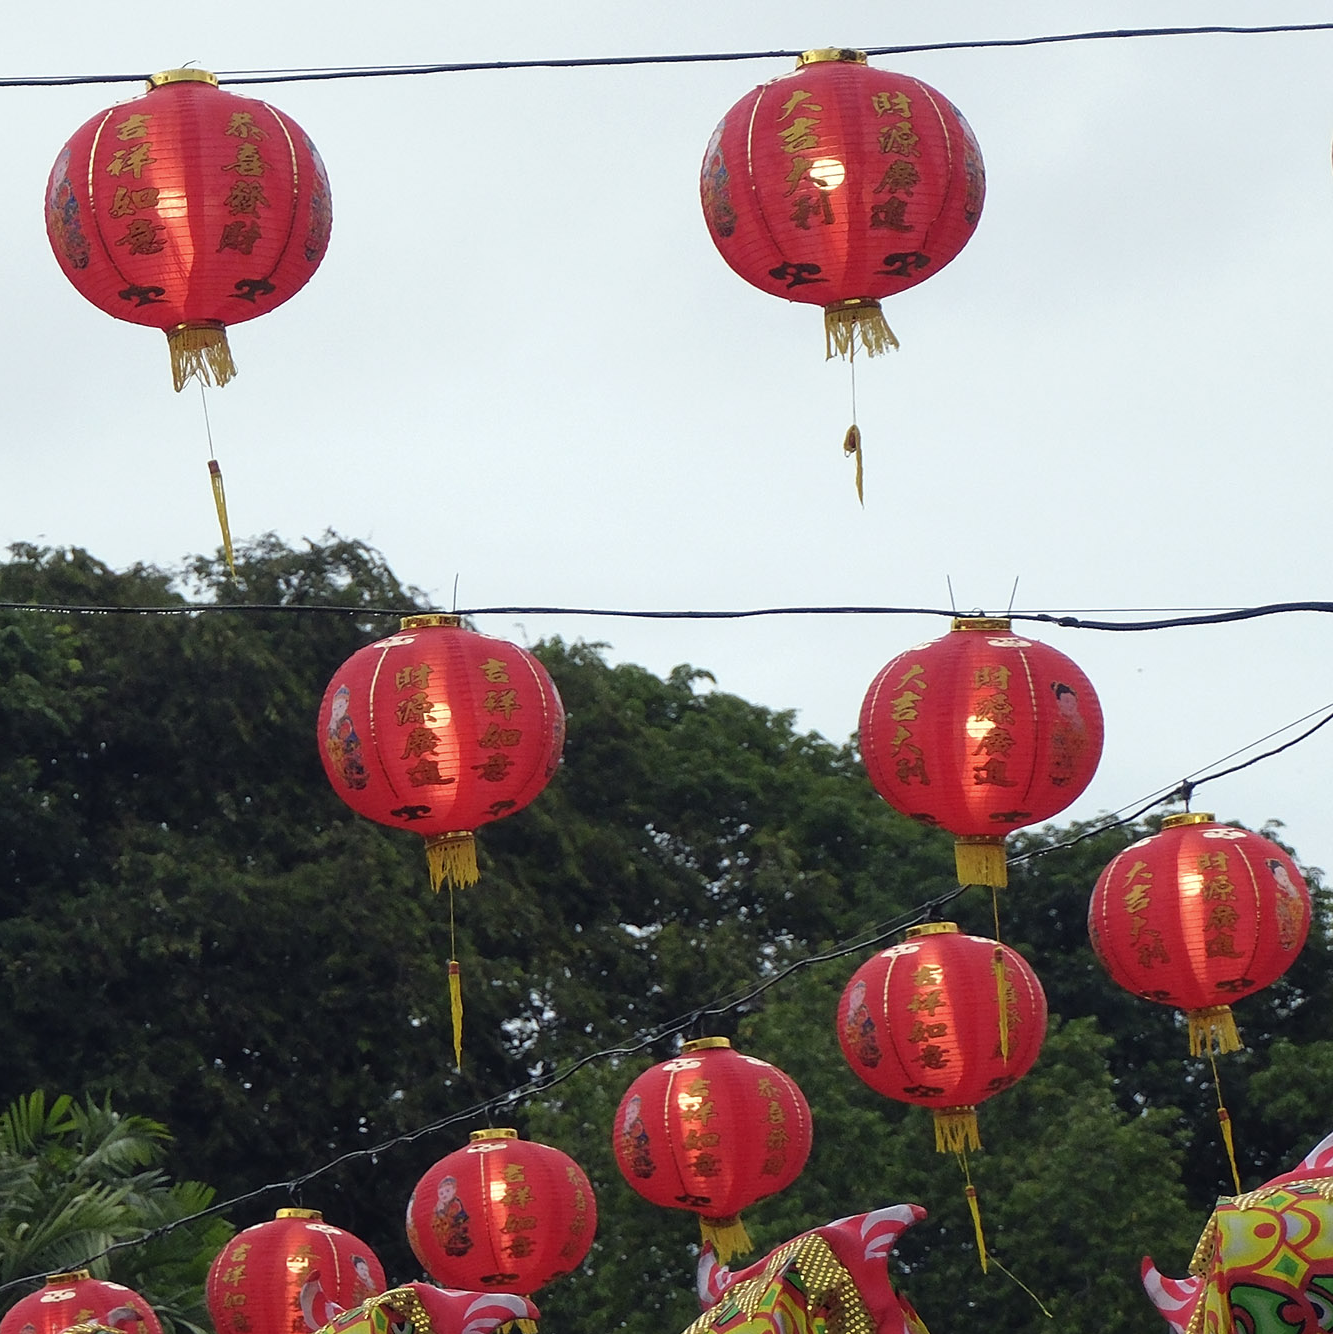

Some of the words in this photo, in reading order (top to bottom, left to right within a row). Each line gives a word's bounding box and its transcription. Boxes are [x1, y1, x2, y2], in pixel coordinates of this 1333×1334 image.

[106, 113, 168, 255] 吉祥如意
[215, 112, 271, 254] 恭喜發財
[776, 90, 835, 230] 大吉大利
[890, 664, 931, 786] 大吉大利
